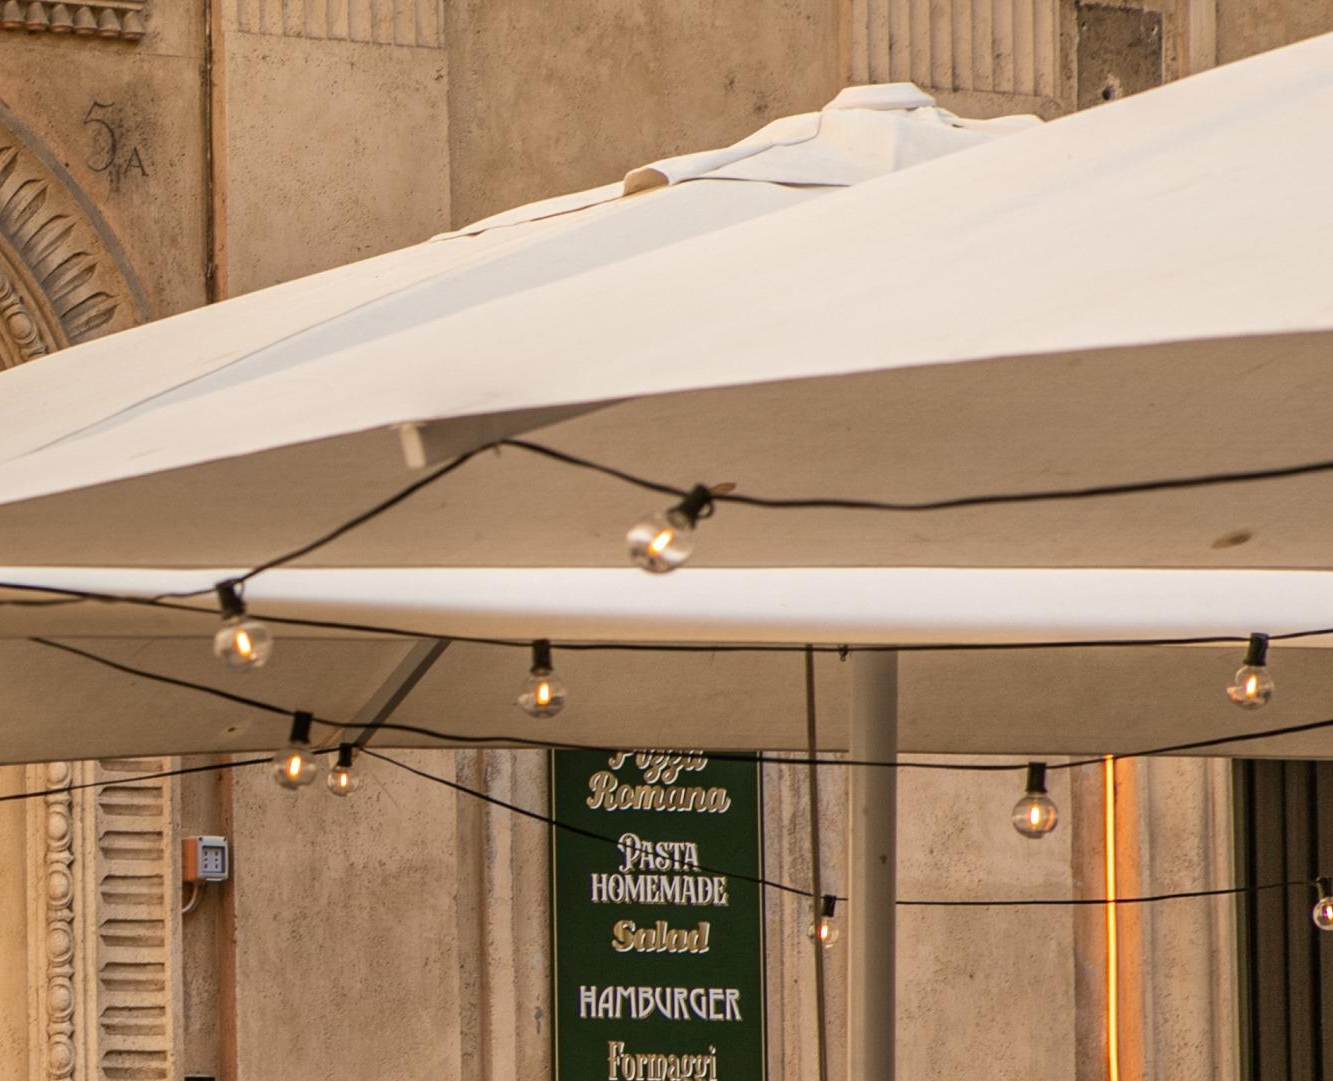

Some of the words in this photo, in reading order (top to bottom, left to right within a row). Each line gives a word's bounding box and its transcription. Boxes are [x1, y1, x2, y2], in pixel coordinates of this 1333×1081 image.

[586, 771, 731, 813] Romana
[617, 832, 700, 873] PASTA
[590, 873, 728, 906] HOMEMADE
[611, 920, 710, 954] Salad
[579, 985, 742, 1021] HAMBURGER
